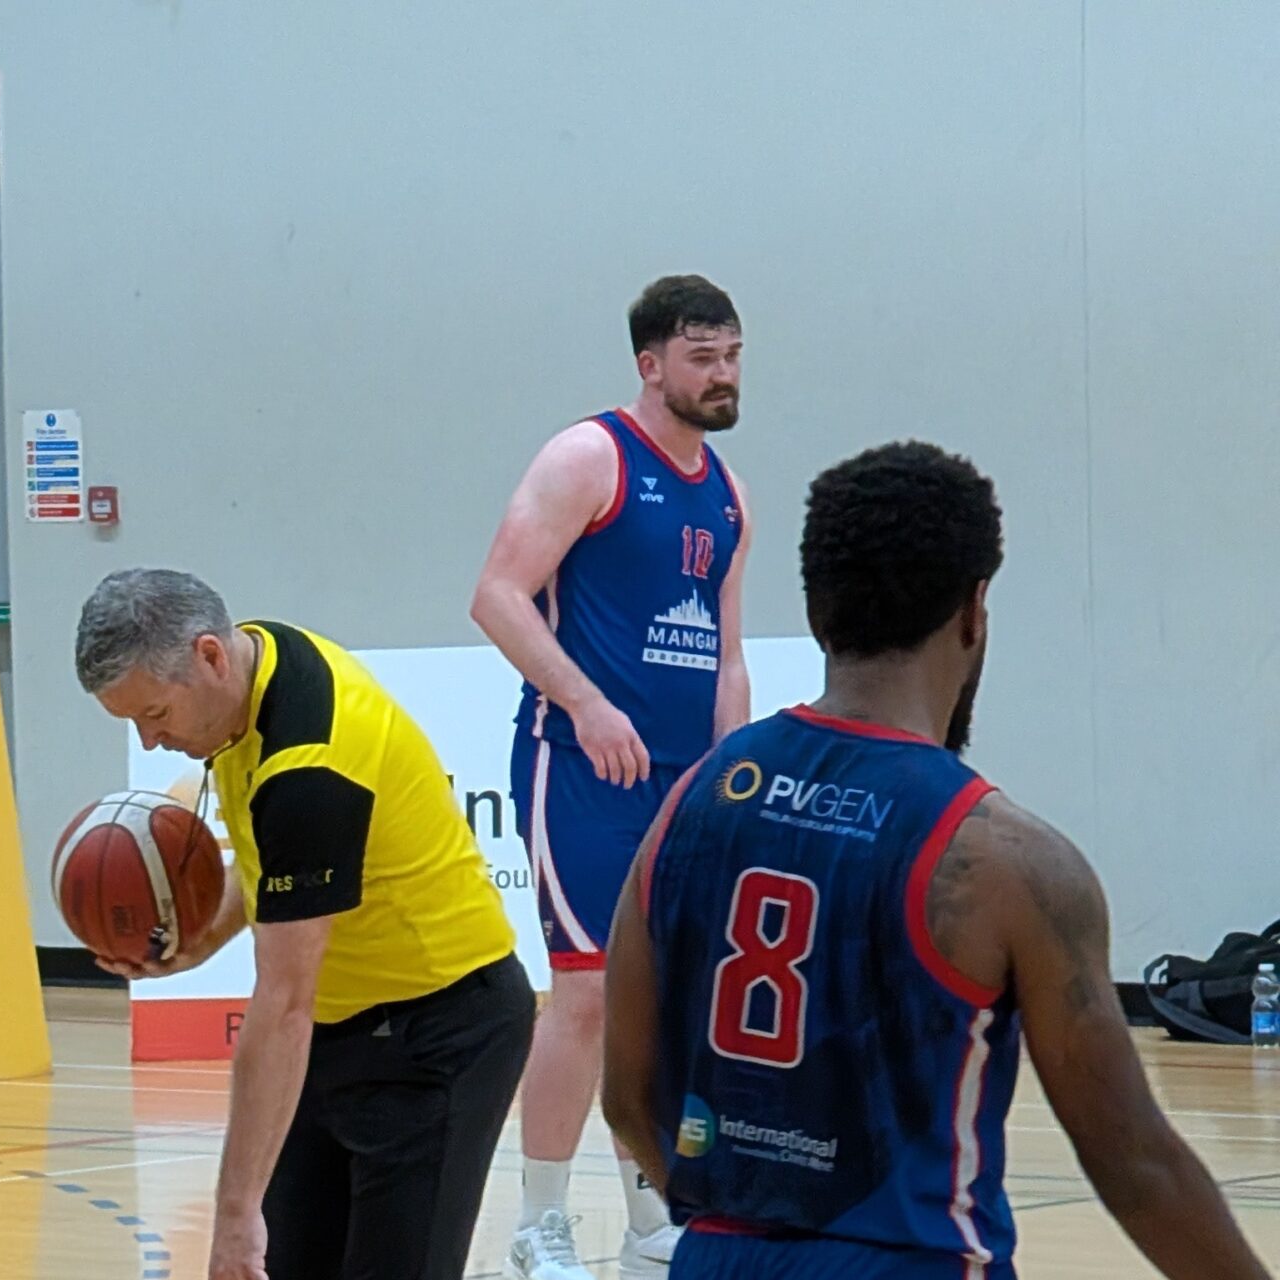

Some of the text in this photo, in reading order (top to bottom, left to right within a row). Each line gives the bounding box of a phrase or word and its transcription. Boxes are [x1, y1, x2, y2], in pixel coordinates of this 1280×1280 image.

[639, 493, 664, 503] vive
[682, 525, 714, 579] 10
[764, 774, 893, 828] PVGEN
[708, 866, 819, 1069] 8
[719, 1114, 838, 1158] International
